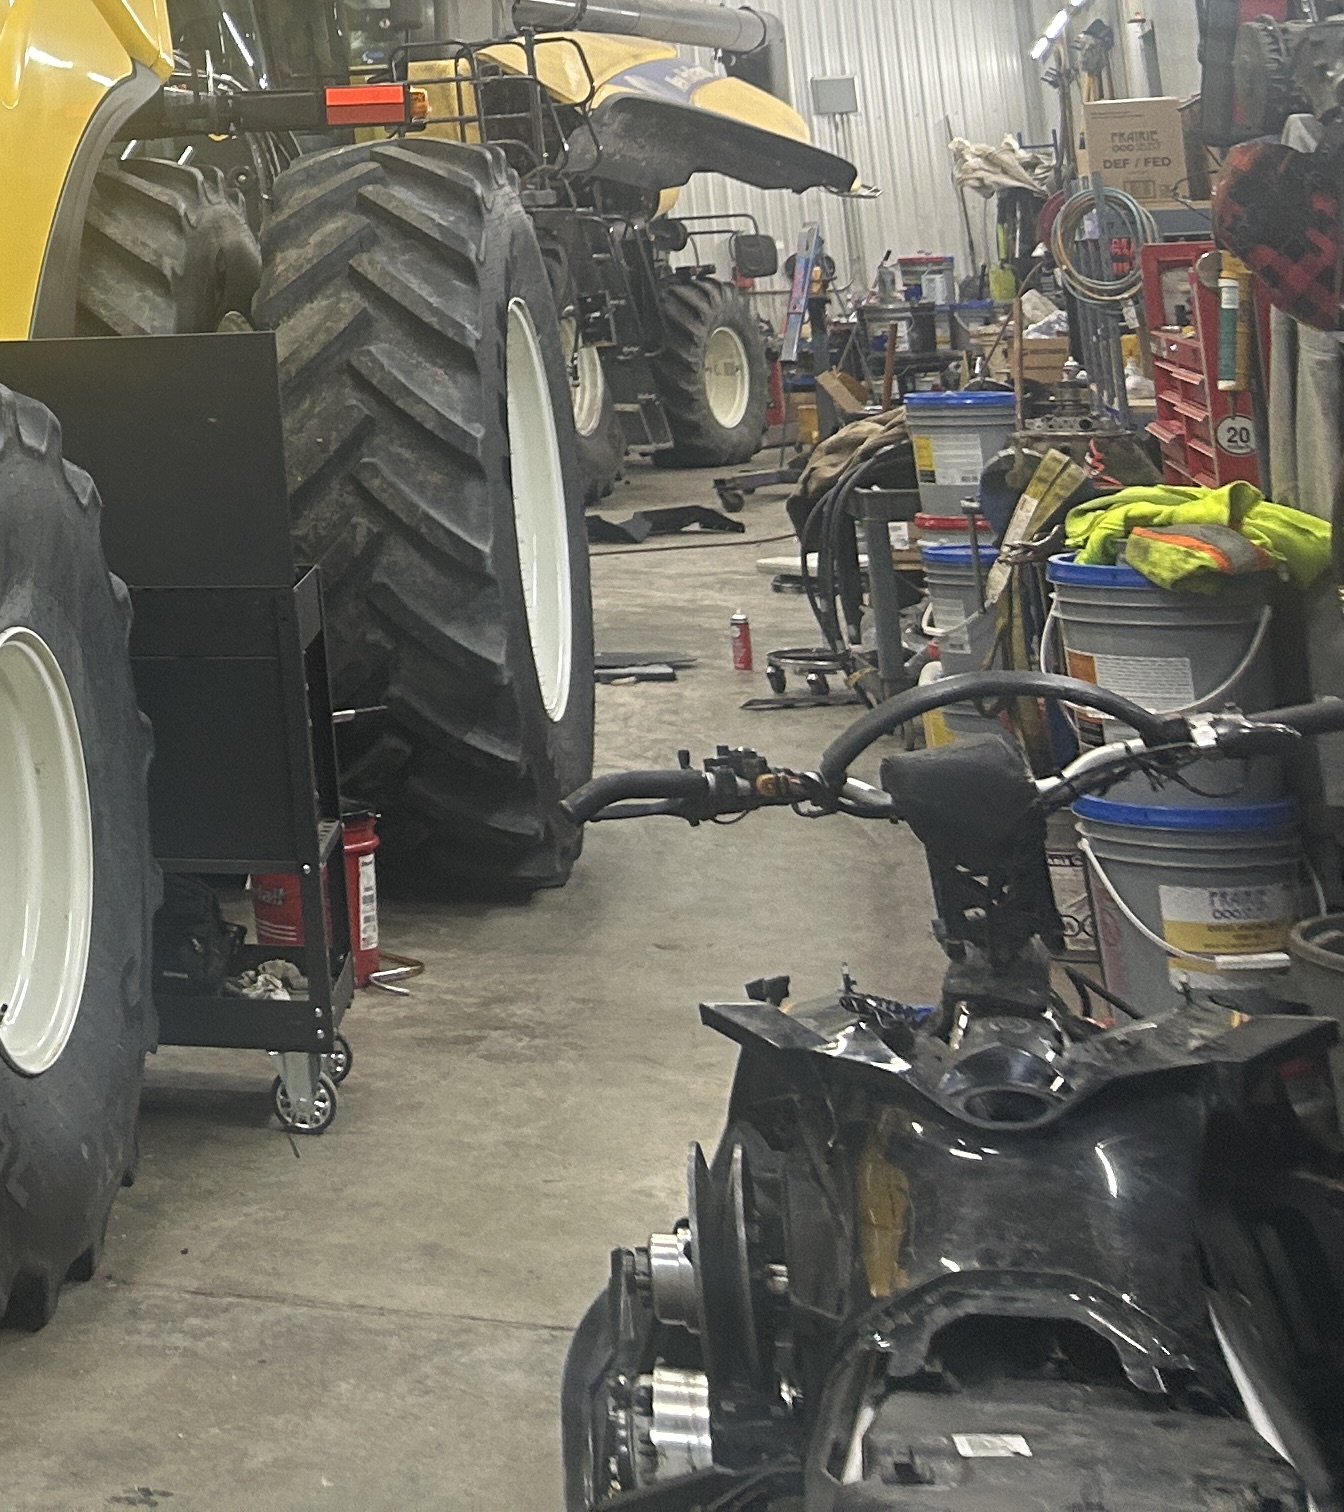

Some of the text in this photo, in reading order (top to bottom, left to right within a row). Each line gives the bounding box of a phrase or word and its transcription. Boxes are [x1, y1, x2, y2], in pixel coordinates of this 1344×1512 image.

[1103, 159, 1130, 169] DEF
[1144, 157, 1171, 167] FED
[1226, 426, 1250, 443] 20
